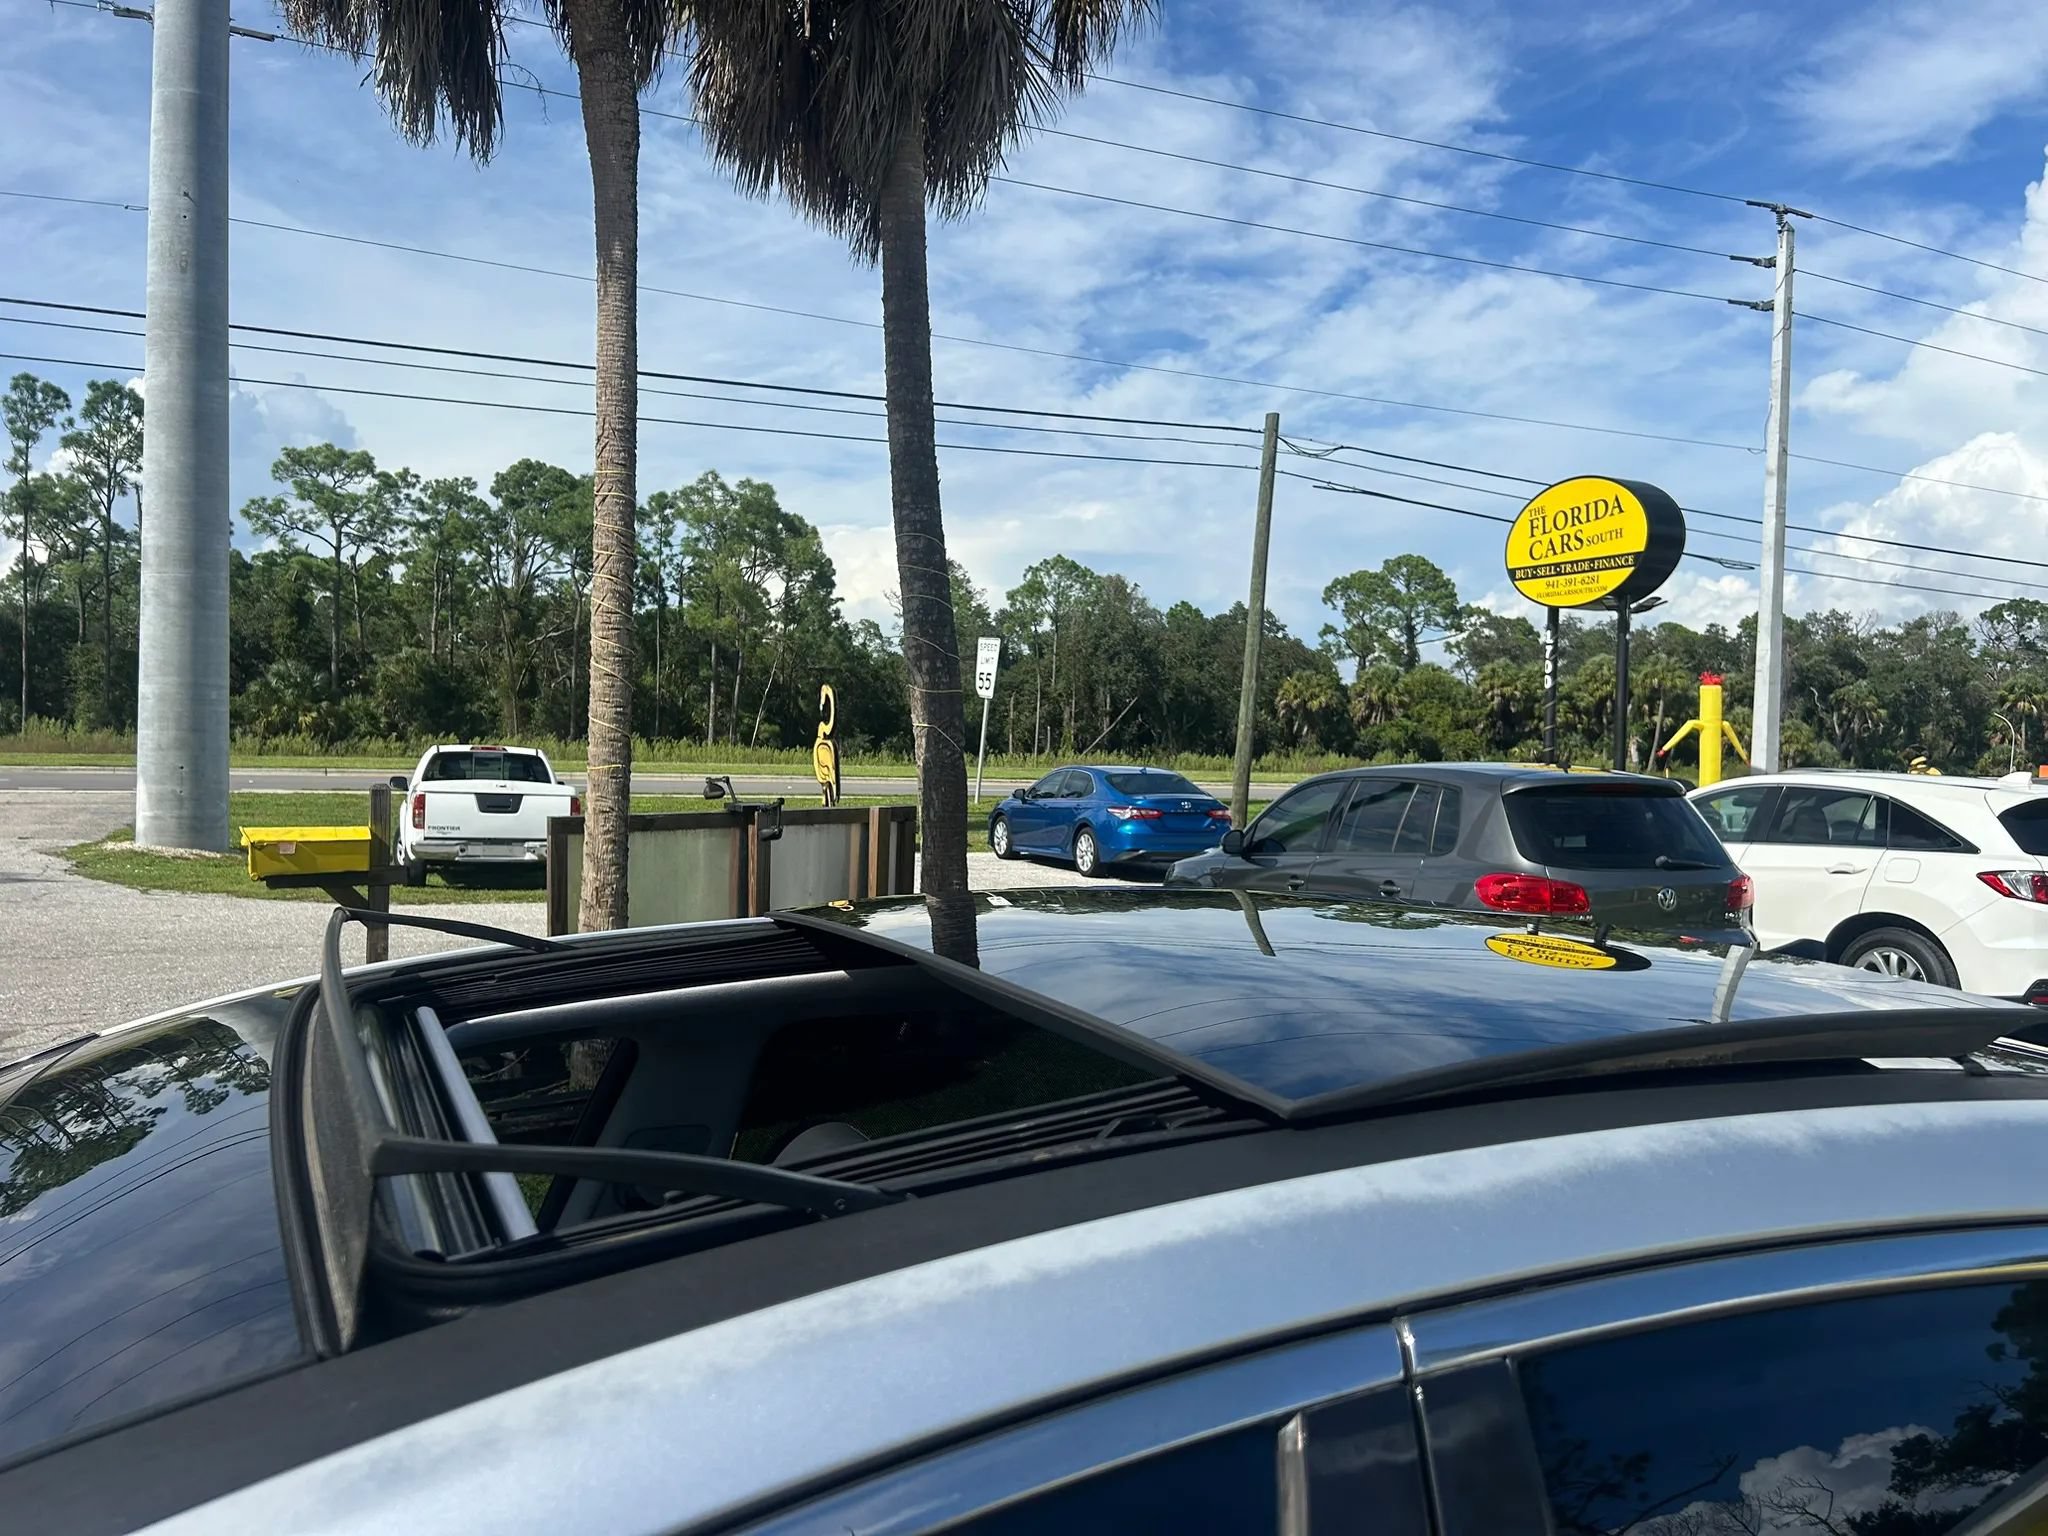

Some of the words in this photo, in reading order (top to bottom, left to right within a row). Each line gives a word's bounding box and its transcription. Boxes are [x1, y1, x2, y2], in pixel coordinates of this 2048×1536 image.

[1528, 505, 1546, 518] THE
[1528, 494, 1624, 539] FLORIDA
[1529, 529, 1585, 561] CARS
[1585, 528, 1624, 547] SOUTH
[1545, 574, 1600, 590] 941-391-6281
[978, 672, 992, 690] 55
